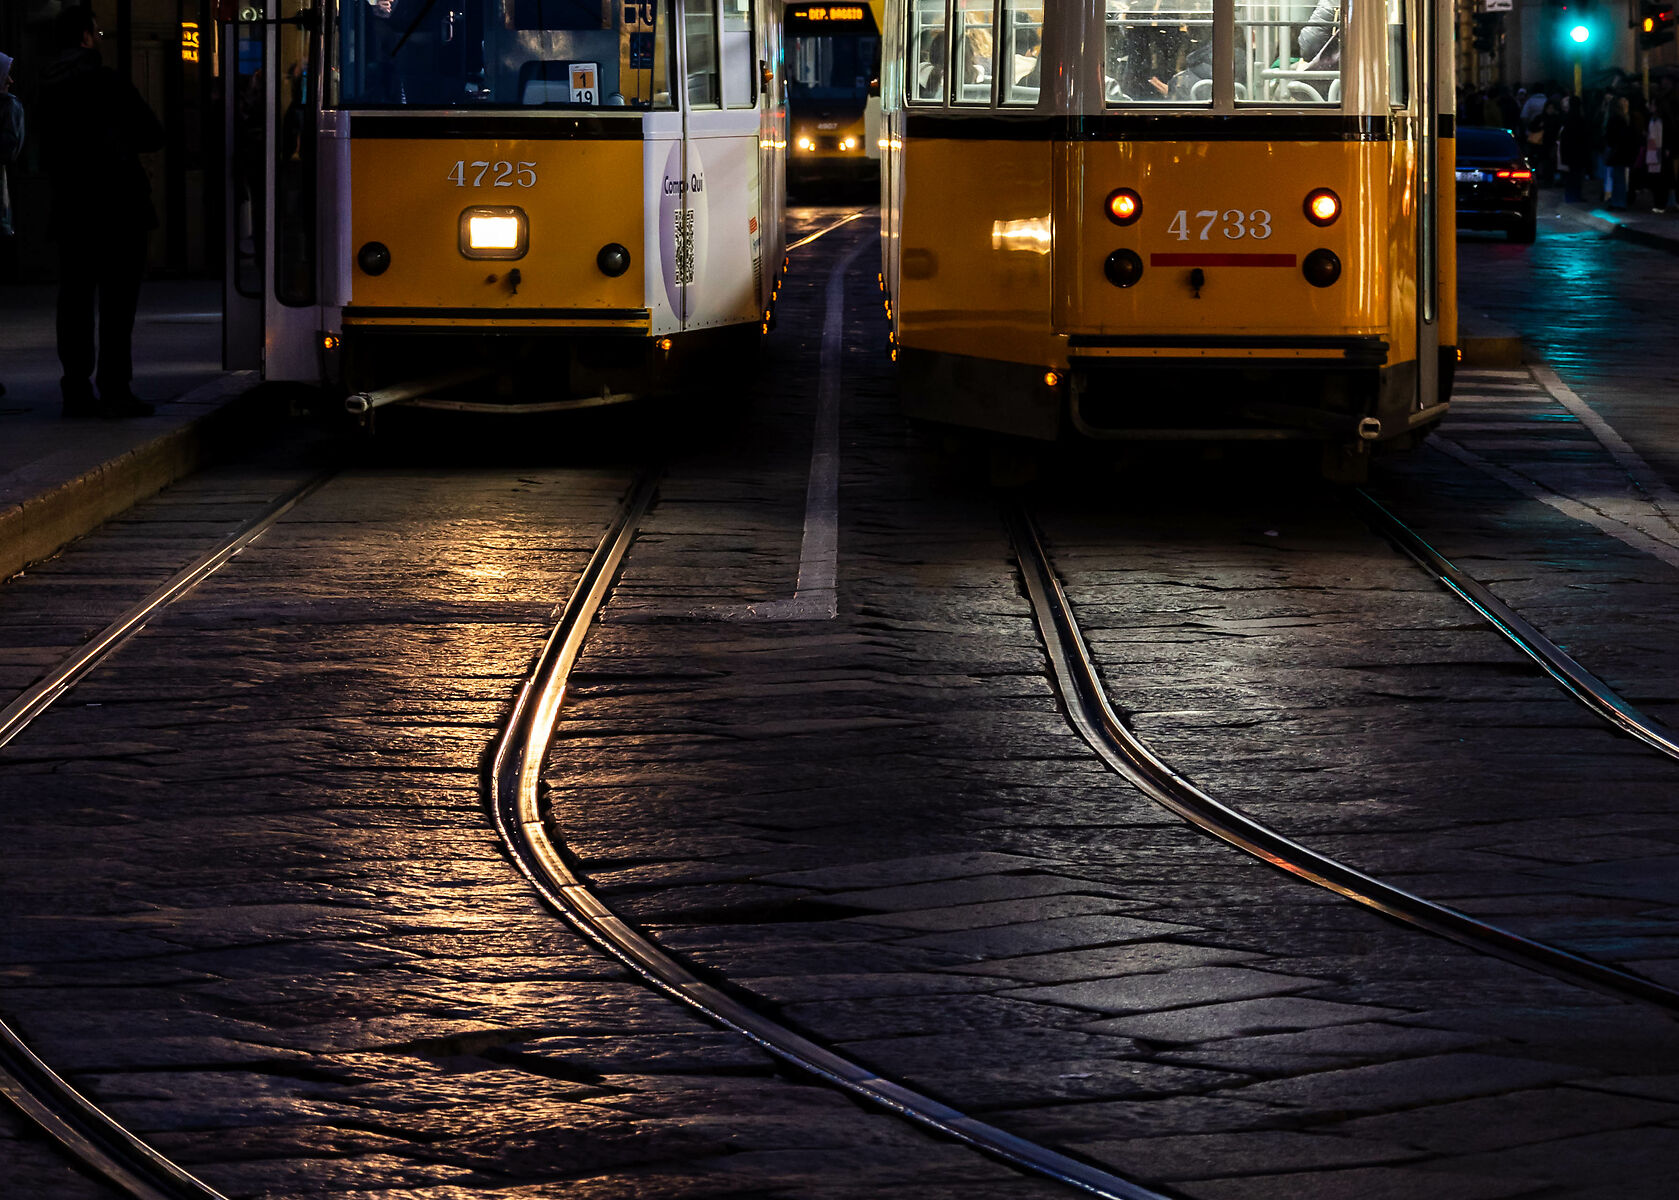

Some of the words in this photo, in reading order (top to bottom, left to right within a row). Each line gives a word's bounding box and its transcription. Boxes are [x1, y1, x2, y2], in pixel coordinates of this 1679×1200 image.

[579, 72, 587, 88] 1
[576, 90, 593, 104] 19
[446, 160, 538, 188] 4725
[1166, 209, 1273, 241] 4733
